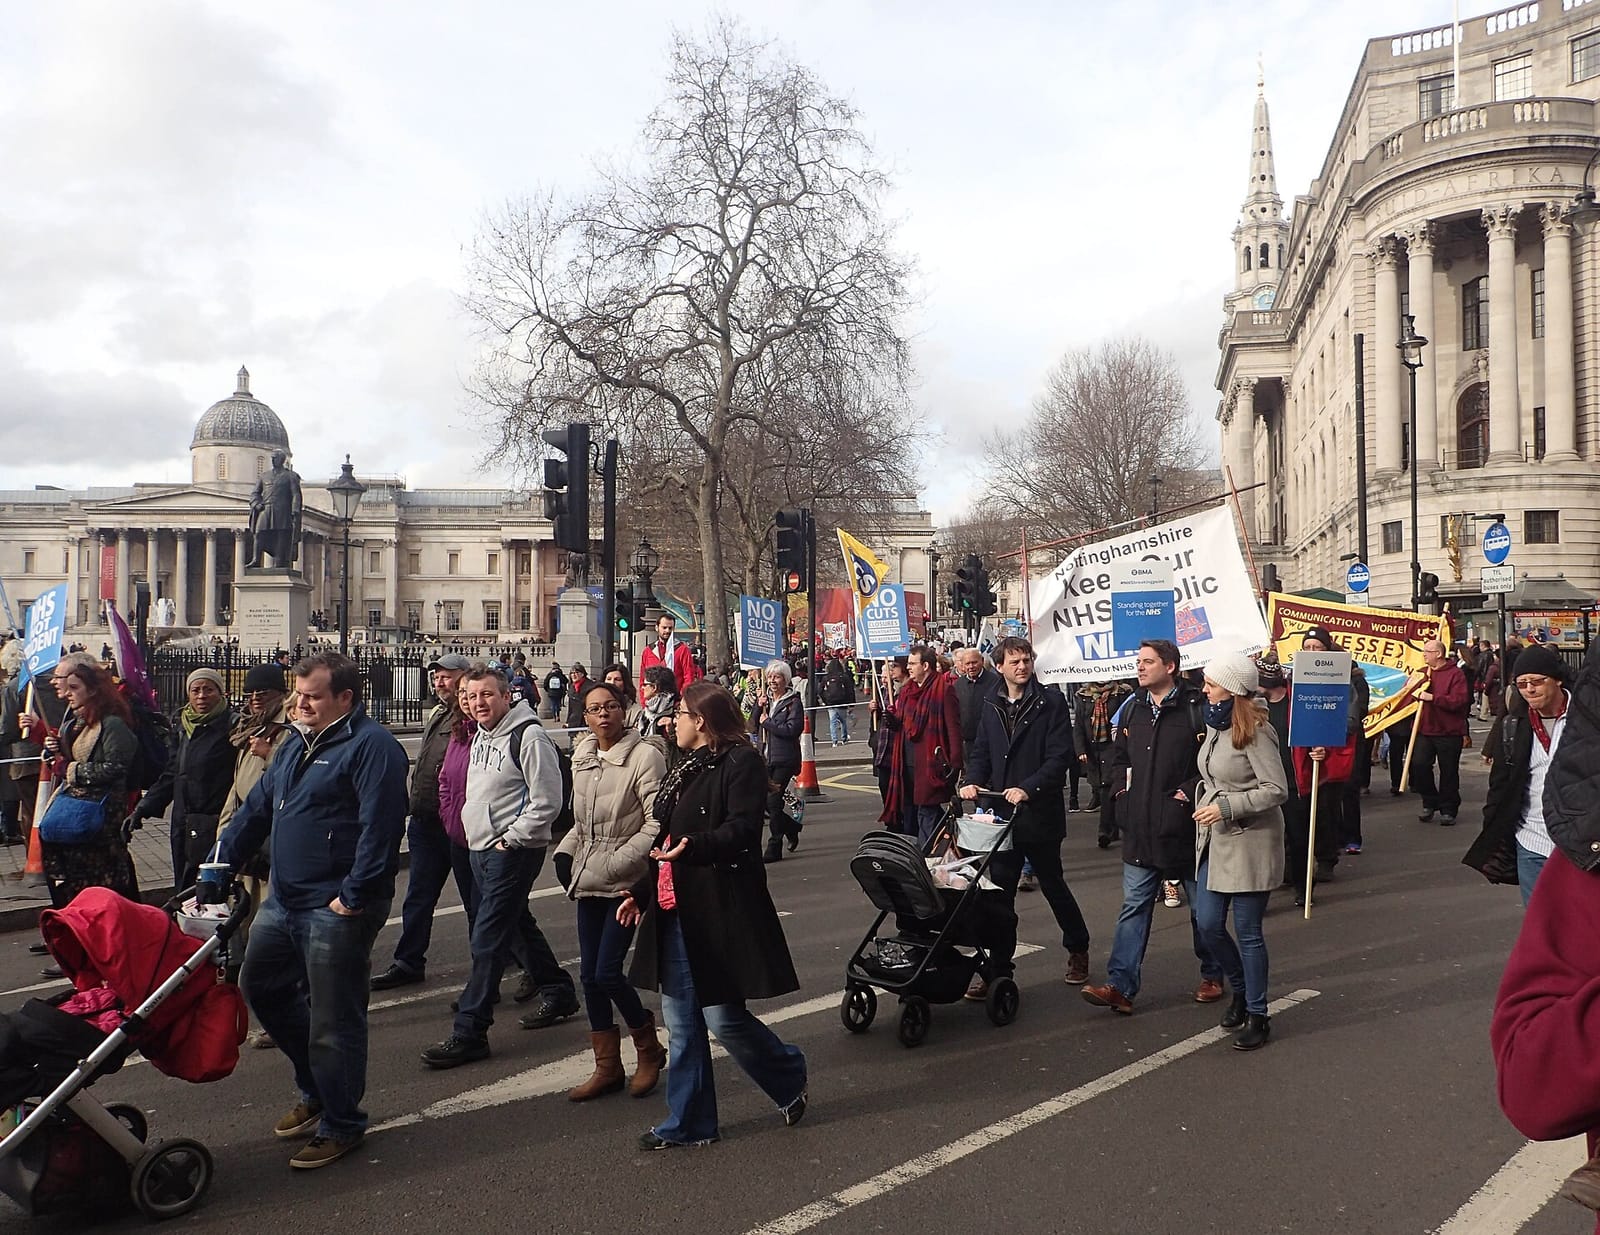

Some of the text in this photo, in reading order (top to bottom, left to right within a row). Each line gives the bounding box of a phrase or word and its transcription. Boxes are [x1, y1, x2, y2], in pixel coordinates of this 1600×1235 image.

[1375, 167, 1564, 223] SUID-AFRIKA
[1055, 527, 1193, 581] Nottinghamshire
[1063, 572, 1111, 600] Kee
[747, 600, 775, 620] NO
[1117, 601, 1168, 609] Standing together
[1146, 608, 1161, 616] NHS
[866, 607, 899, 620] CUTS
[1278, 607, 1361, 628] COMMUNICATION
[748, 617, 775, 633] CUTS
[749, 630, 775, 642] CLOSURES
[1298, 694, 1344, 703] Standing together
